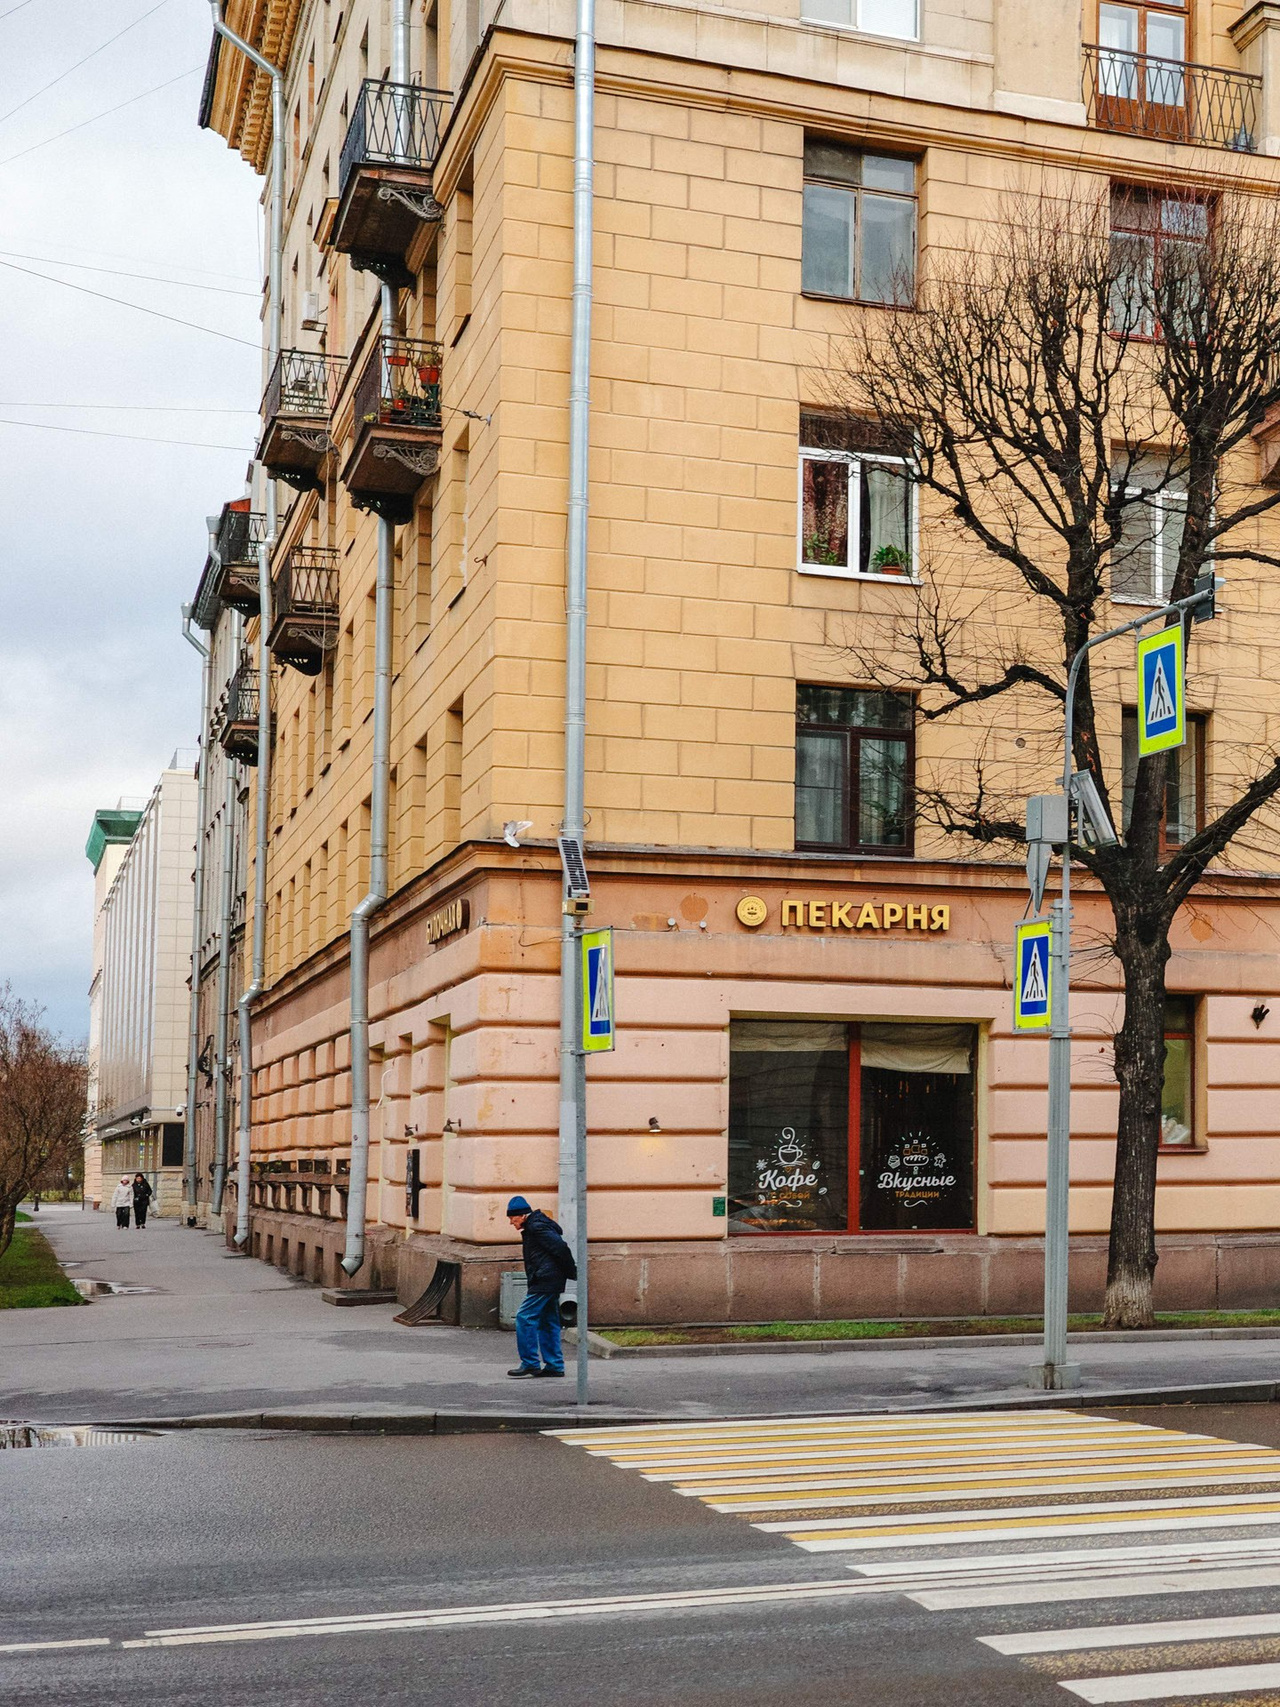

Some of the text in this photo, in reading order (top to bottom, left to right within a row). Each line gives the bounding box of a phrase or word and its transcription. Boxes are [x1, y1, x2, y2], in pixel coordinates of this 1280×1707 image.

[781, 900, 949, 930] ПЕКАРНЯ
[758, 1168, 818, 1191] Кофе
[877, 1172, 956, 1191] Вкусные
